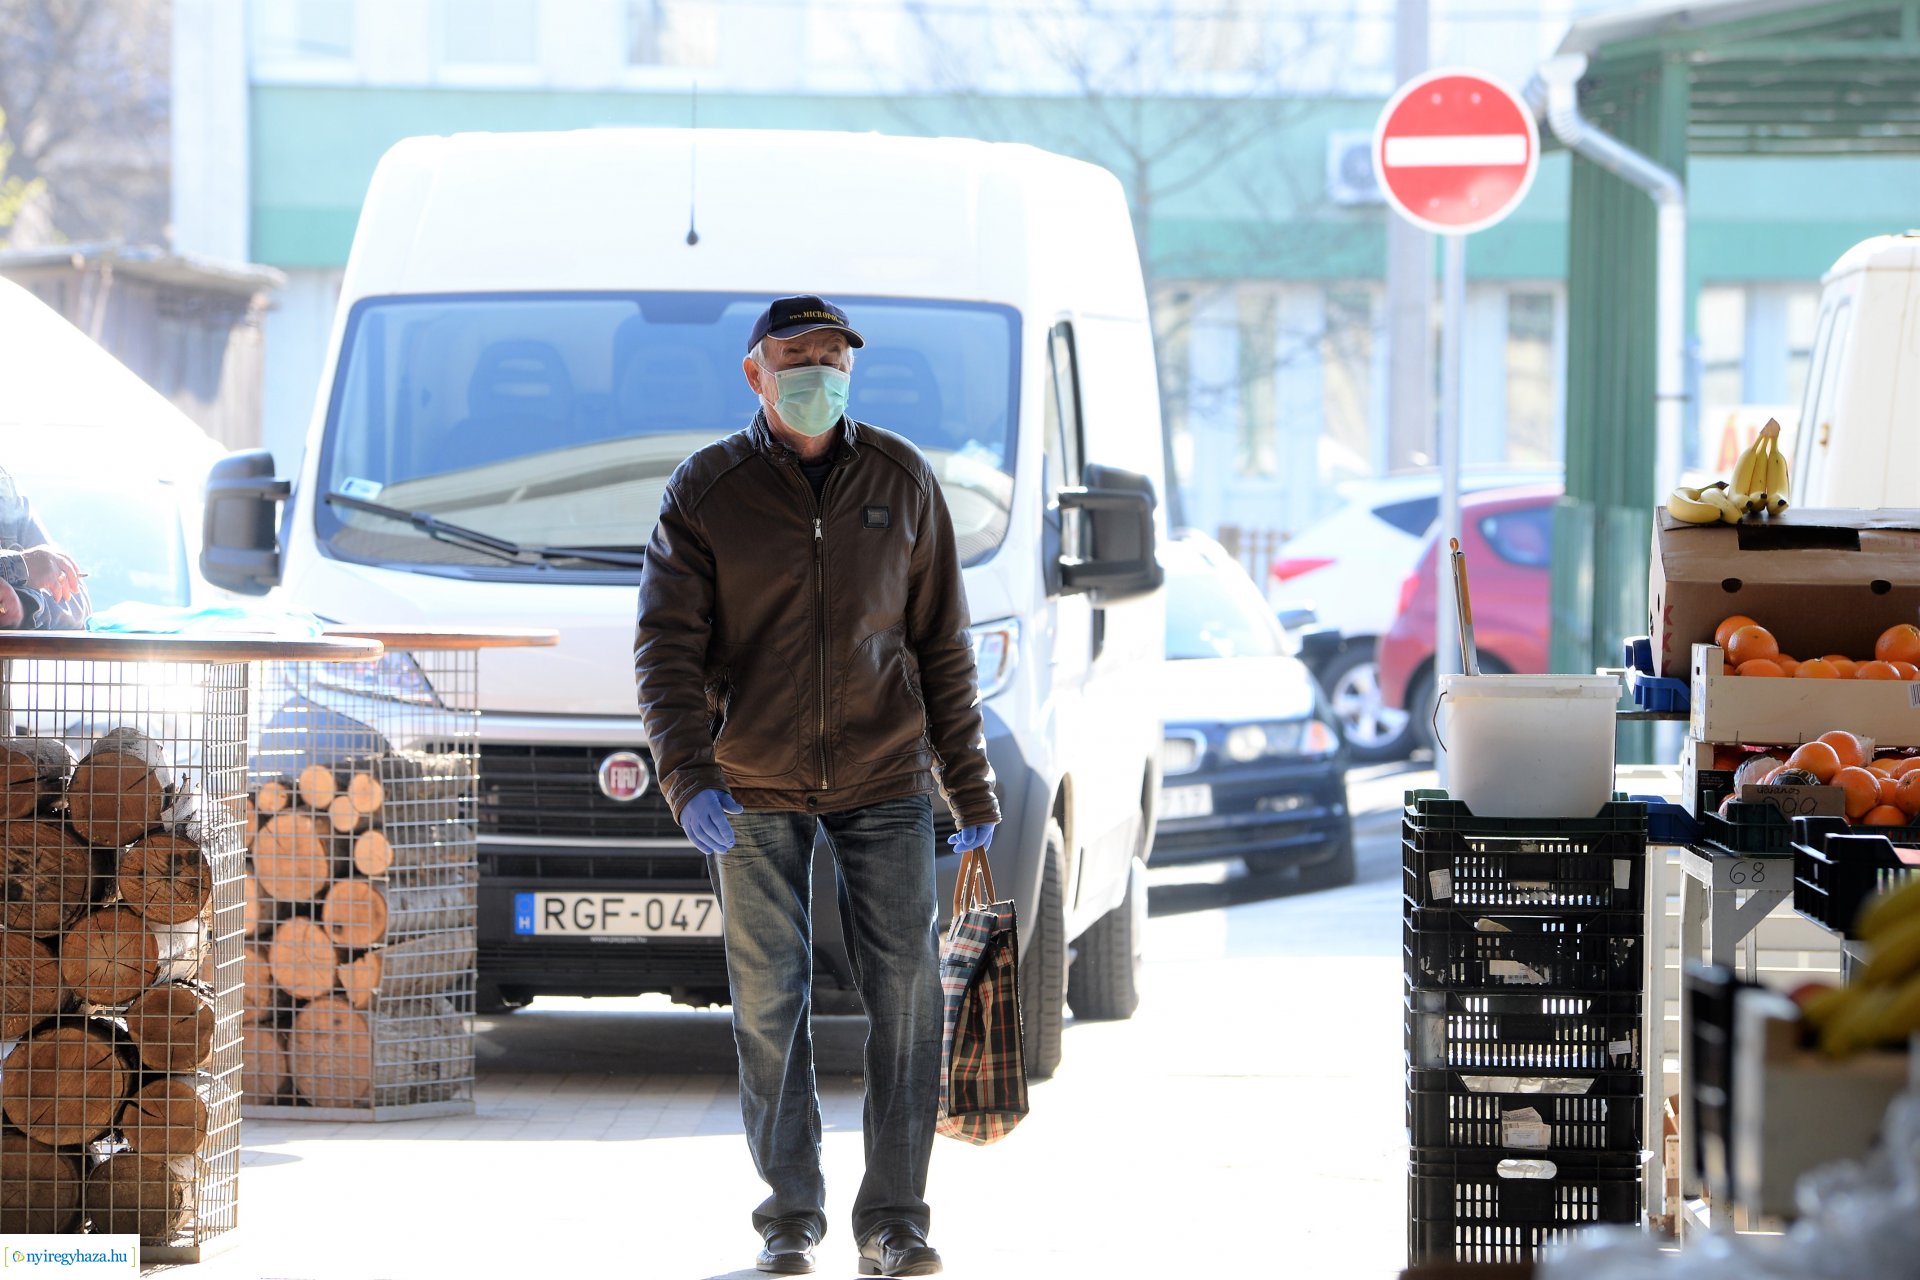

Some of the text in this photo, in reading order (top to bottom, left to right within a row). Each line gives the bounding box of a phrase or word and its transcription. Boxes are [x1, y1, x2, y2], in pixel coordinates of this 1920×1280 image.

[611, 767, 639, 788] FIAT
[1729, 861, 1765, 885] 68
[518, 898, 713, 931] H RGF-047
